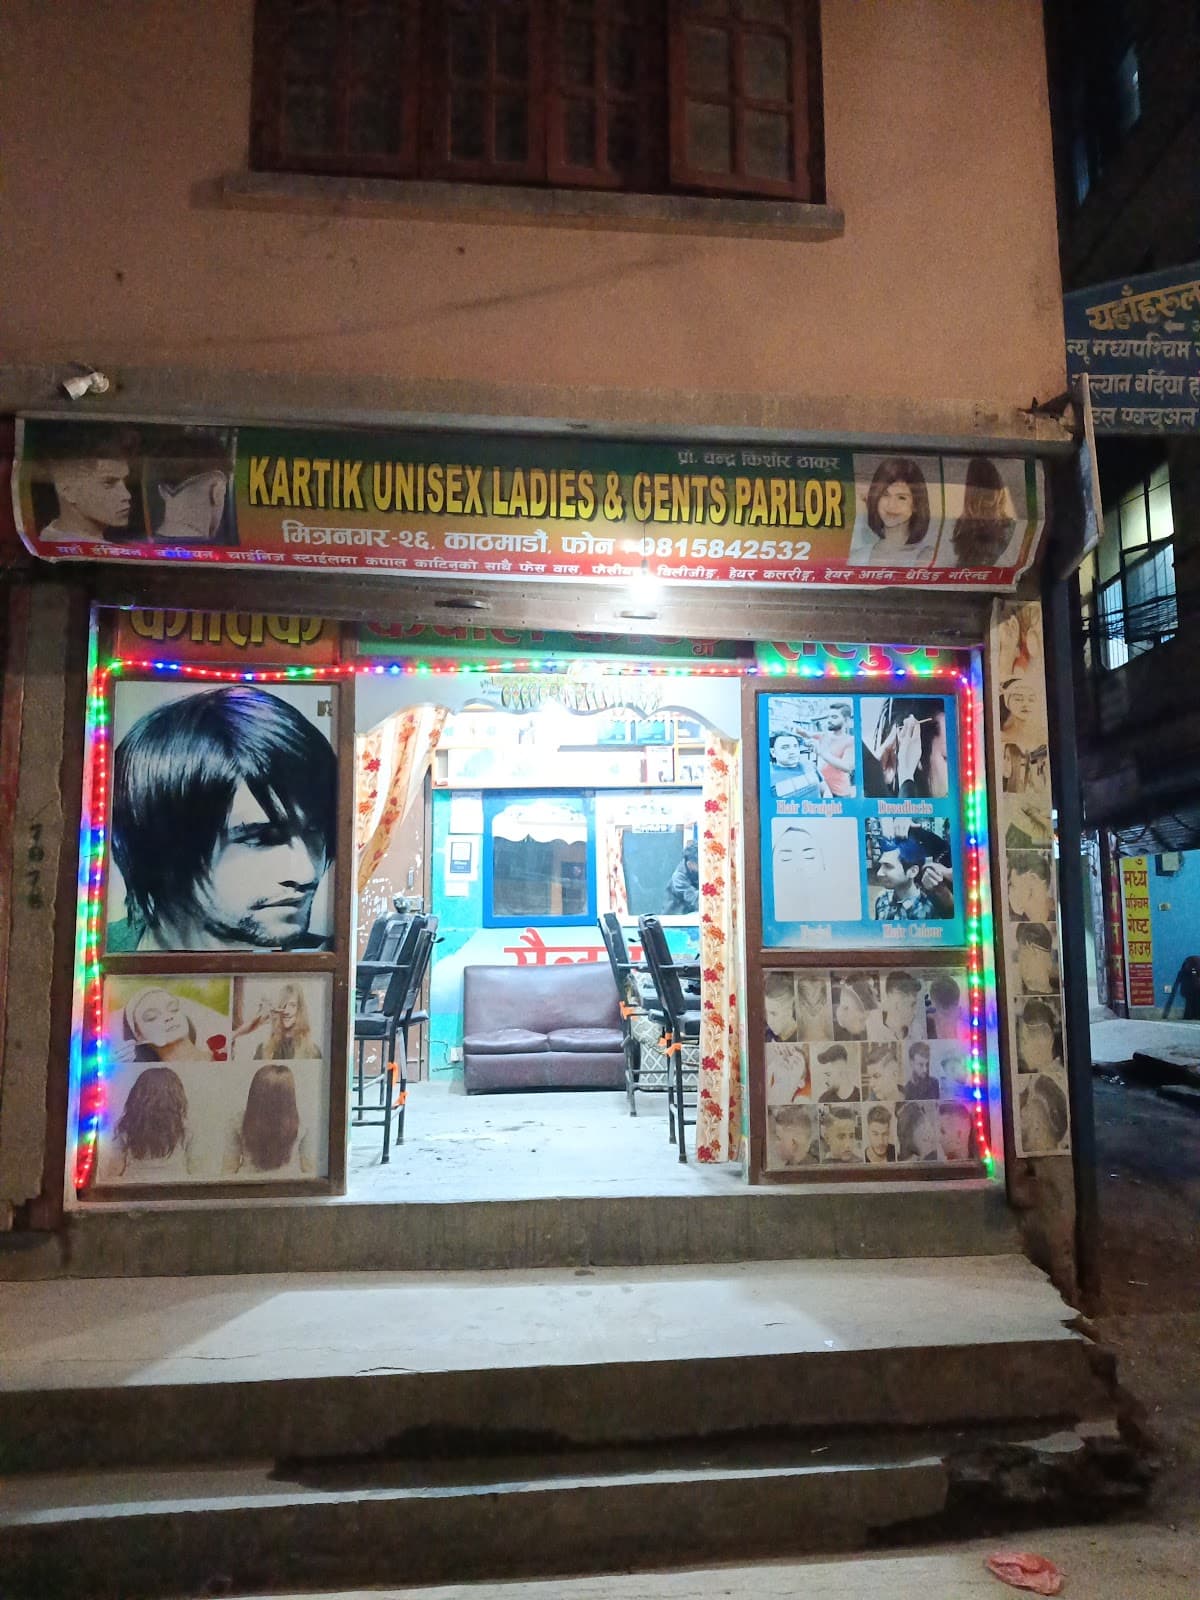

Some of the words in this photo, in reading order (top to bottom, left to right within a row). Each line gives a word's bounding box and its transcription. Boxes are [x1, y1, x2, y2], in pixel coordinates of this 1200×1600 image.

[250, 456, 364, 509] KARTIK
[373, 462, 484, 515] UNISEX
[492, 466, 596, 520] LADIES
[604, 471, 624, 520] &
[632, 473, 728, 525] GENTS
[734, 477, 845, 528] PARLOR
[561, 531, 616, 556] फोन
